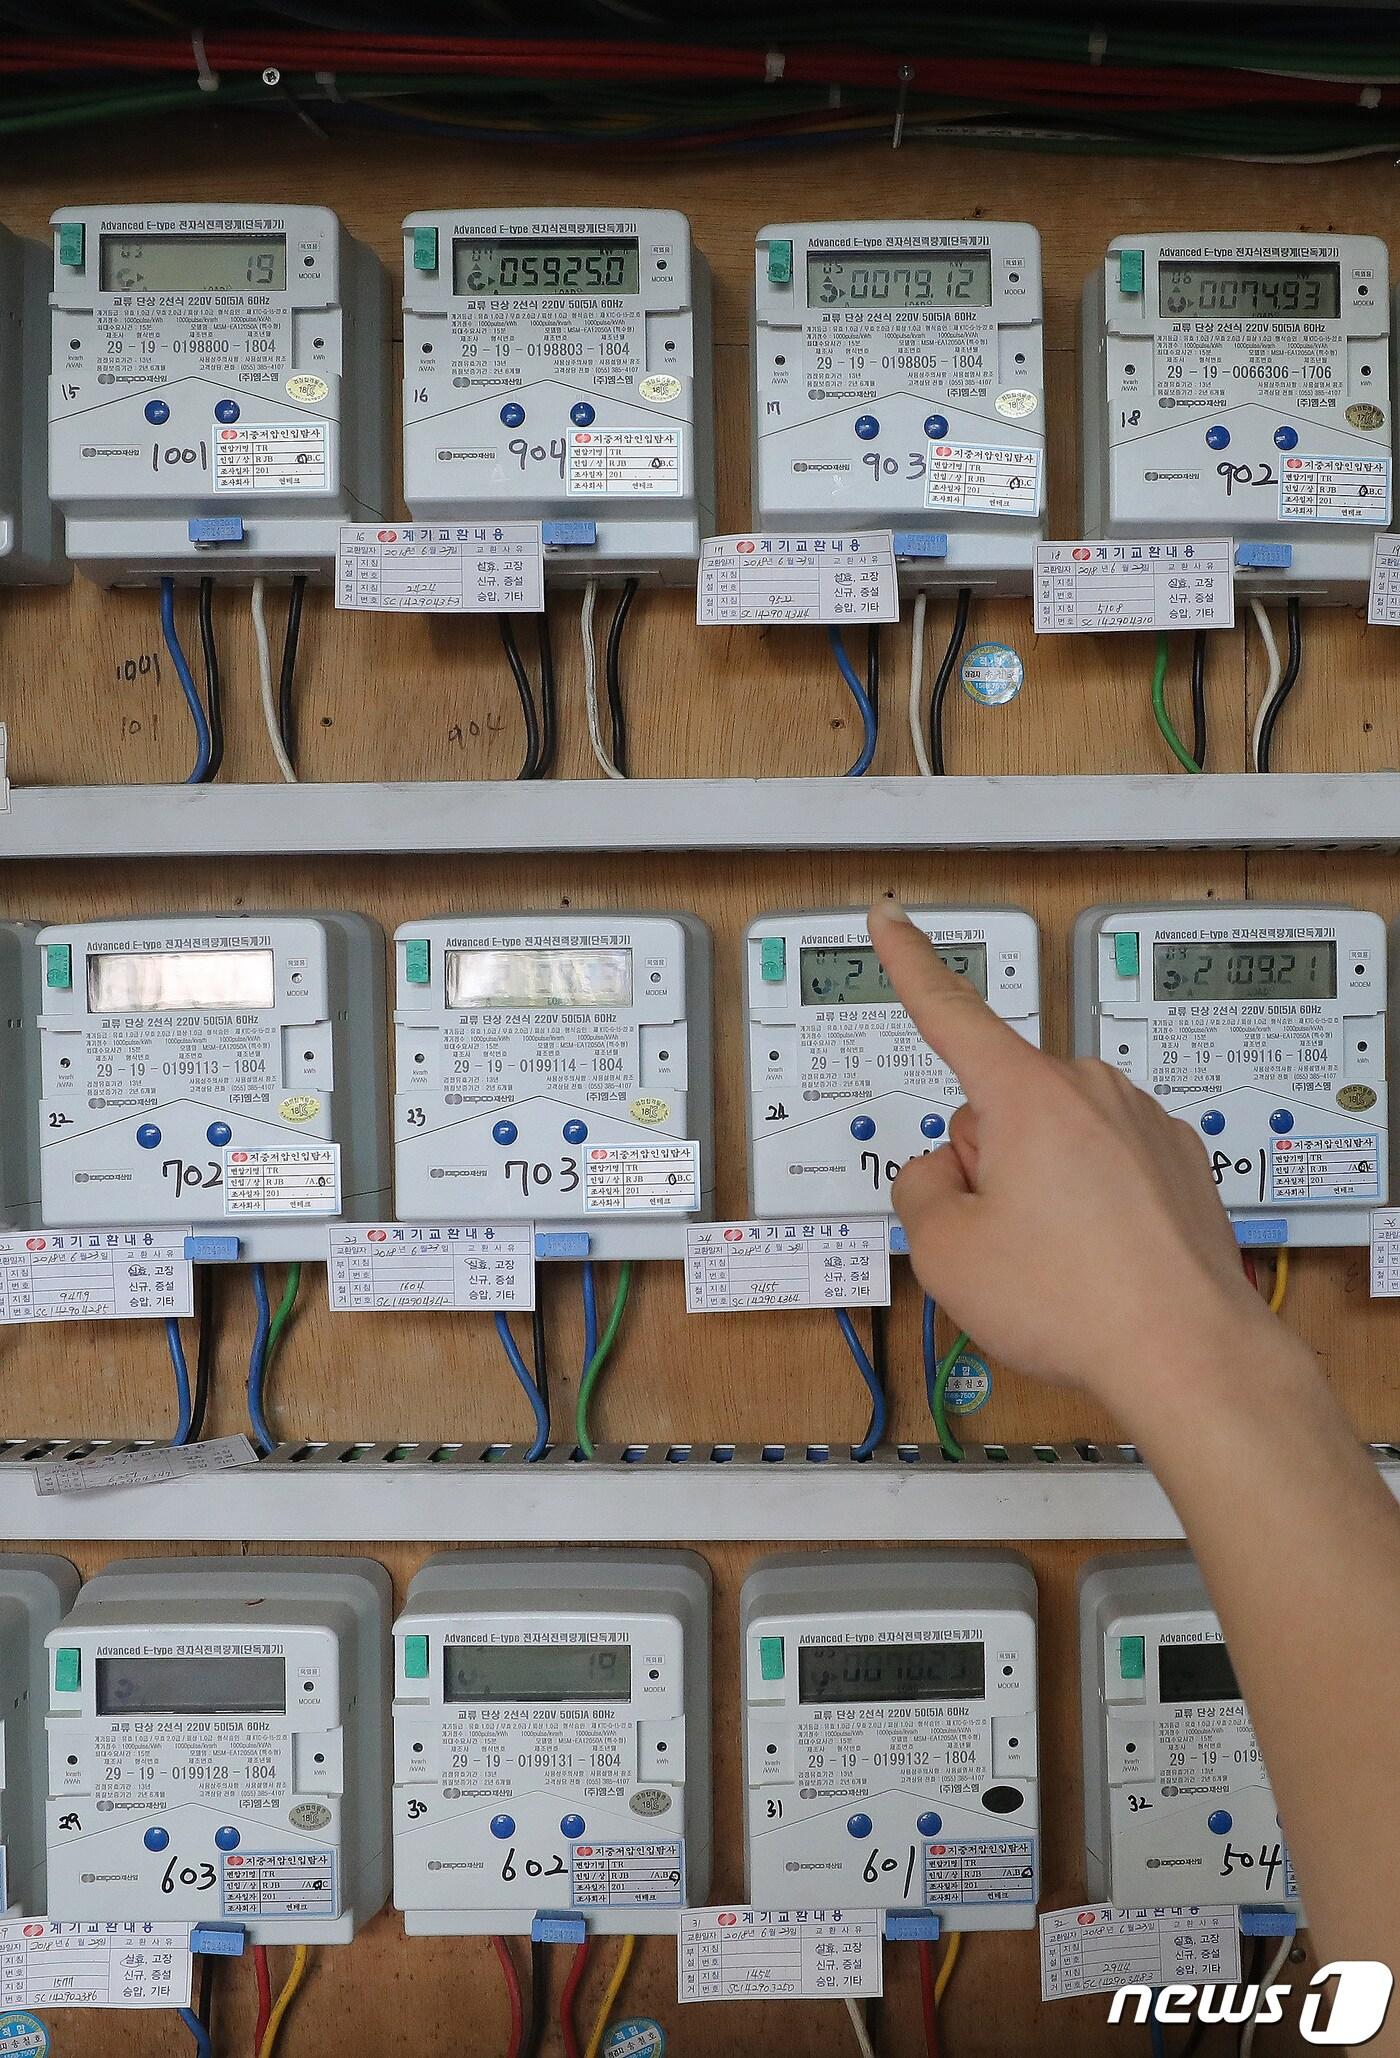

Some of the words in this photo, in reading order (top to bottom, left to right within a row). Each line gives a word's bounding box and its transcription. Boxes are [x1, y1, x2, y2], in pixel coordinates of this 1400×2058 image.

[101, 221, 143, 230] Advanced
[146, 221, 175, 230] E-type
[454, 225, 497, 234] Advanced
[500, 225, 528, 235] E-type
[1160, 248, 1202, 257] Advanced
[1204, 248, 1232, 257] E-type
[159, 296, 184, 306] 2선식
[188, 296, 211, 306] 220V
[248, 296, 270, 305] 60Hz
[1217, 323, 1242, 332] 2선식
[1246, 323, 1268, 332] 220V
[1304, 323, 1325, 332] 60Hz
[107, 341, 122, 354] 29
[140, 341, 155, 353] 19
[173, 340, 229, 353] 0198800
[244, 339, 275, 352] 1804
[462, 344, 477, 357] 29
[495, 344, 510, 357] 19
[527, 344, 583, 356] 0198803
[598, 343, 629, 355] 1804
[817, 357, 832, 369] 29
[850, 356, 864, 369] 19
[882, 356, 936, 369] 0198805
[952, 355, 983, 368] 1804
[1168, 366, 1182, 378] 29
[1203, 366, 1217, 378] 19
[1233, 366, 1288, 378] 0066306
[1301, 366, 1331, 378] 1706
[62, 384, 80, 400] 15
[414, 389, 428, 402] 16
[1121, 410, 1141, 427] 18
[152, 441, 207, 471] 1001
[508, 438, 566, 479] 904
[863, 453, 926, 481] 903
[1217, 462, 1278, 495] 902
[504, 561, 523, 571] 고장
[504, 590, 523, 601] 기타
[1155, 929, 1197, 939] Advanced
[1200, 929, 1228, 939] E-type
[87, 940, 130, 950] Advanced
[133, 940, 162, 949] E-type
[446, 938, 489, 947] Advanced
[492, 938, 521, 947] E-type
[505, 1014, 531, 1024] 2선식
[535, 1014, 558, 1023] 220V
[594, 1014, 616, 1023] 60Hz
[812, 1056, 826, 1069] 29
[845, 1056, 860, 1069] 19
[877, 1055, 932, 1068] 0199115
[1163, 1051, 1178, 1064] 29
[1195, 1050, 1210, 1063] 19
[1227, 1050, 1282, 1063] 0199116
[1297, 1049, 1327, 1062] 1804
[97, 1064, 112, 1077] 29
[130, 1063, 145, 1076] 19
[163, 1062, 218, 1075] 0199113
[234, 1060, 265, 1073] 1804
[454, 1060, 469, 1073] 29
[488, 1060, 503, 1073] 19
[520, 1059, 576, 1072] 0199114
[592, 1058, 623, 1071] 1804
[49, 1113, 74, 1127] 22
[407, 1107, 426, 1126] 23
[163, 1159, 223, 1197] 702
[504, 1158, 579, 1196] 703
[800, 1634, 843, 1643] Advanced
[846, 1633, 874, 1643] E-type
[1160, 1633, 1202, 1643] Advanced
[97, 1646, 140, 1655] Advanced
[144, 1646, 173, 1655] E-type
[504, 1710, 529, 1719] 2선식
[533, 1710, 556, 1719] 220V
[592, 1710, 615, 1719] 60Hz
[453, 1755, 468, 1768] 29
[486, 1754, 501, 1767] 19
[518, 1754, 572, 1767] 0199131
[590, 1753, 620, 1766] 1804
[809, 1755, 823, 1768] 29
[842, 1754, 856, 1767] 19
[874, 1752, 929, 1766] 0199132
[945, 1751, 976, 1764] 1804
[1170, 1753, 1185, 1766] 29
[1202, 1751, 1217, 1765] 19
[105, 1767, 121, 1781] 29
[139, 1767, 154, 1780] 19
[172, 1766, 228, 1779] 0199128
[245, 1766, 276, 1778] 1804
[407, 1800, 427, 1818] 30
[767, 1800, 783, 1818] 31
[1128, 1795, 1153, 1811] 32
[502, 1848, 569, 1881] 602
[1220, 1844, 1282, 1890] 504
[161, 1856, 217, 1893] 603
[863, 1846, 915, 1899] 601
